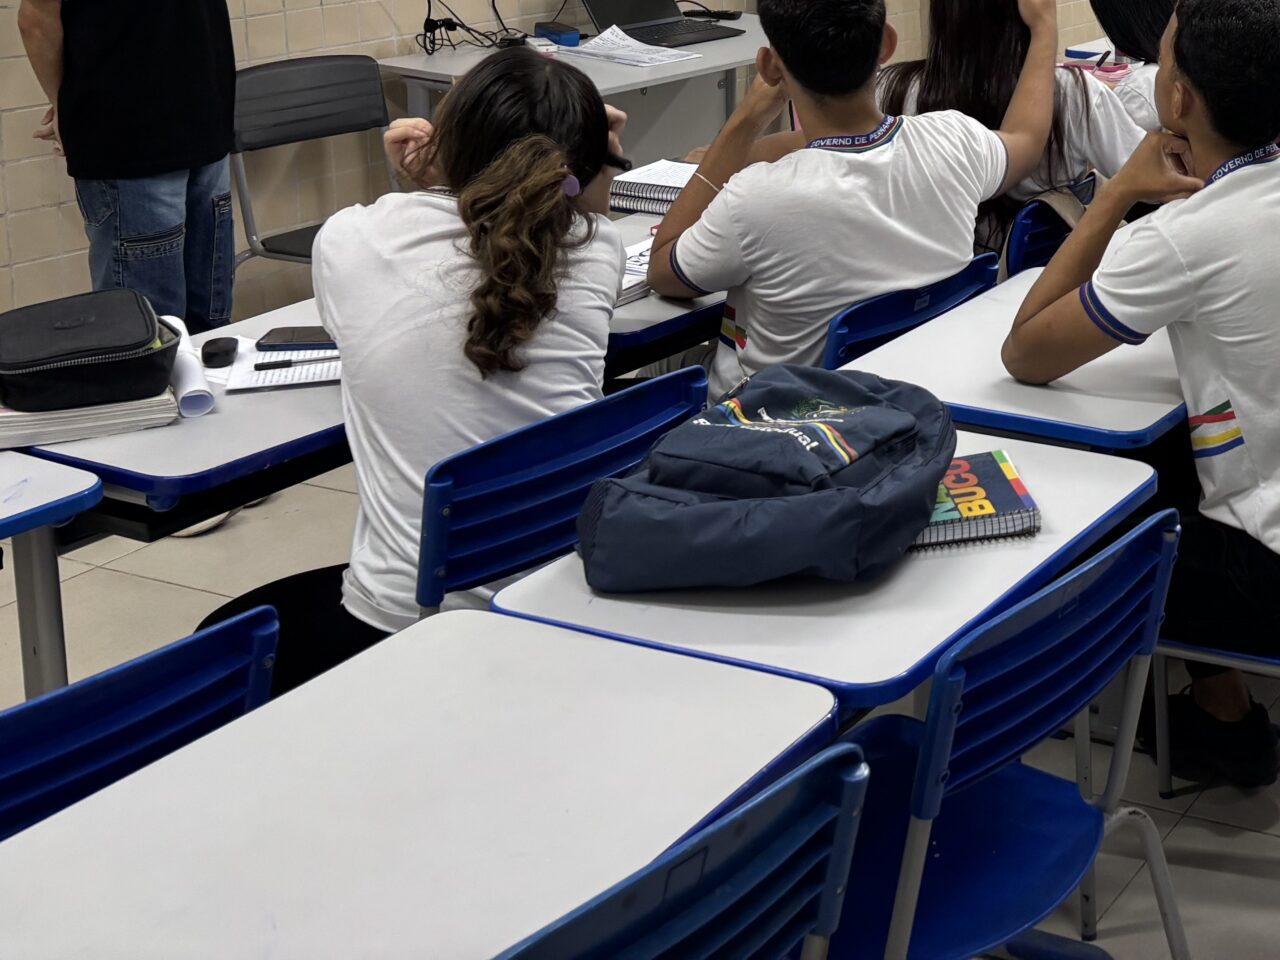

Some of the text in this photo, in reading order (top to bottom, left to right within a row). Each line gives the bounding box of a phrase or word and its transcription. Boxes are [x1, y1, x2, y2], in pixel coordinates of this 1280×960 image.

[854, 136, 868, 145] DE
[1211, 152, 1254, 182] GOVERNO
[1254, 147, 1265, 159] DE
